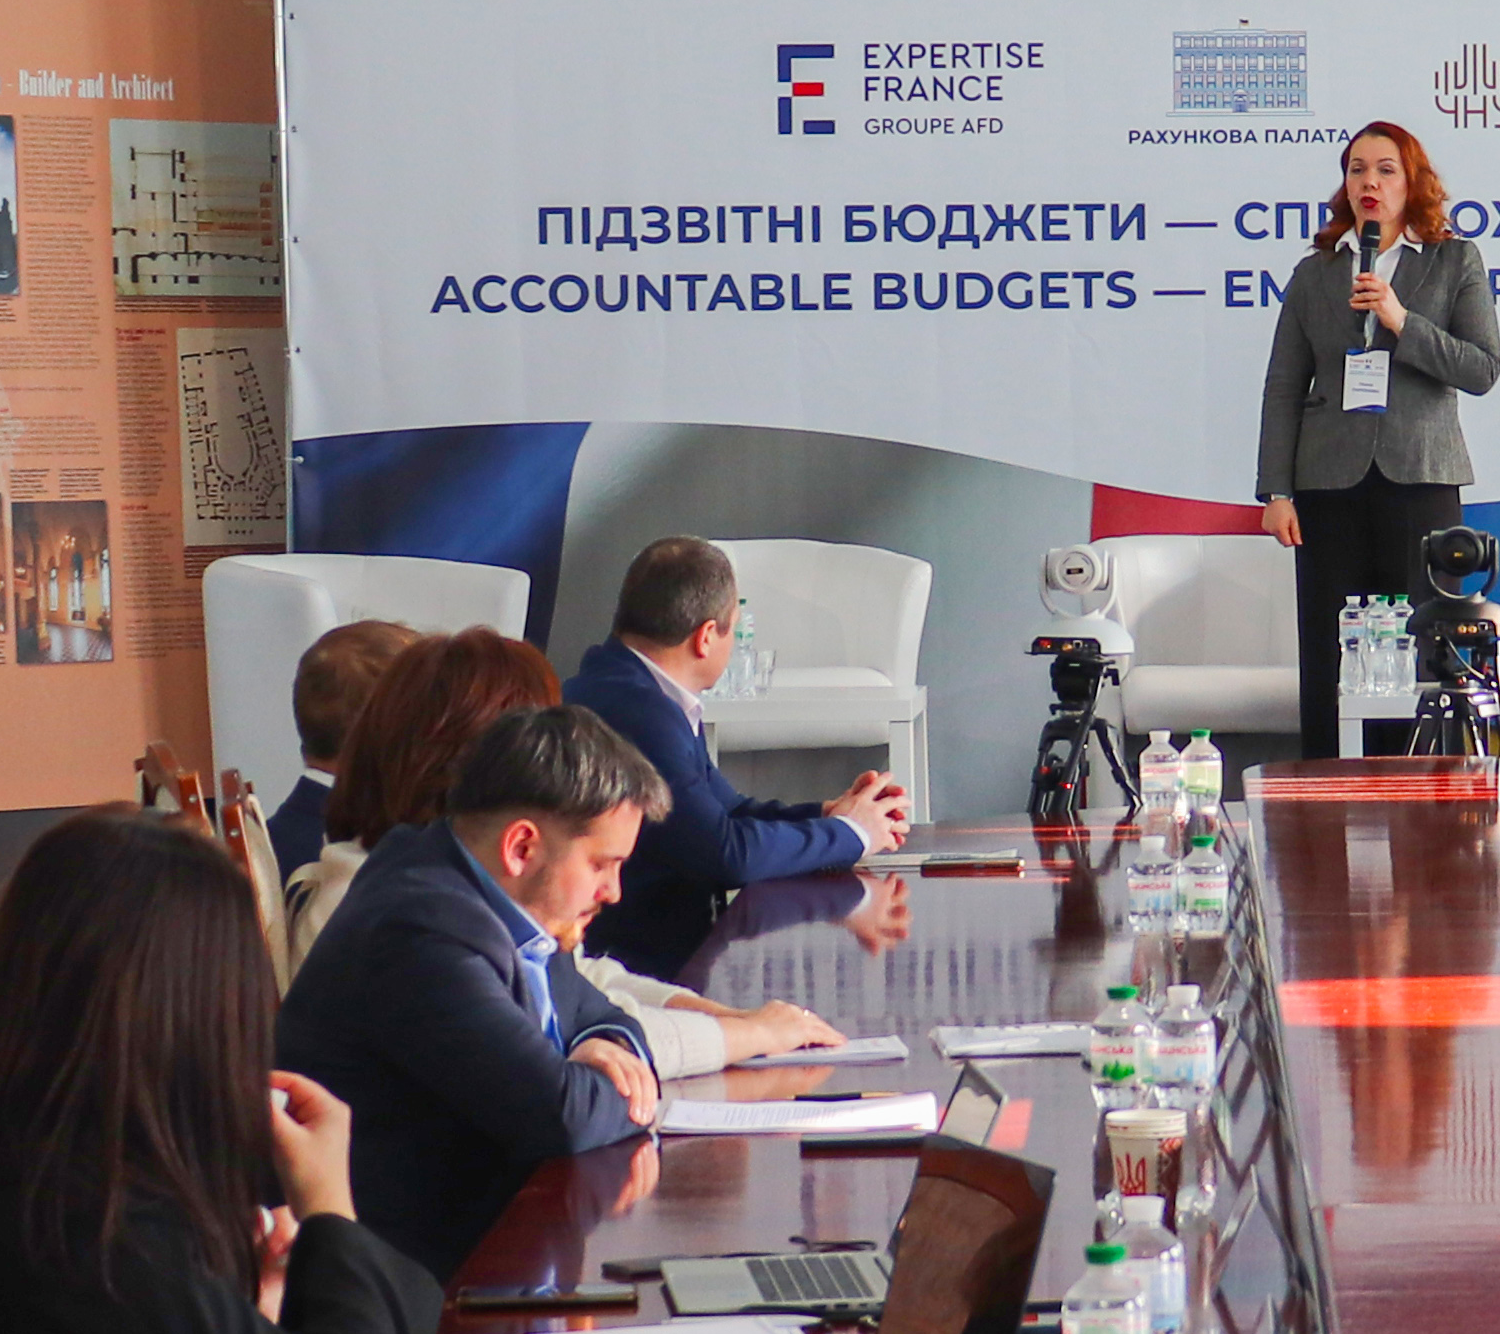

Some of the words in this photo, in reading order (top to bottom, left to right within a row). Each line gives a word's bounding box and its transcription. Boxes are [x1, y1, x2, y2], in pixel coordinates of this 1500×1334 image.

[864, 43, 1044, 69] EXPERTISE
[19, 69, 72, 98] Builder
[77, 73, 104, 99] and
[109, 73, 175, 101] Architect
[864, 76, 1003, 102] FRANCE
[864, 118, 955, 135] GROUPE
[961, 118, 1003, 134] AFD
[1128, 130, 1258, 145] РАХУНКОВА
[1264, 129, 1351, 144] ПАЛАТА
[537, 204, 823, 251] ПІДЗВІТНІ
[843, 202, 1147, 249] БЮДЖЕТИ
[431, 273, 853, 314] ACCOUNTABLE
[875, 269, 1137, 312] BUDGETS
